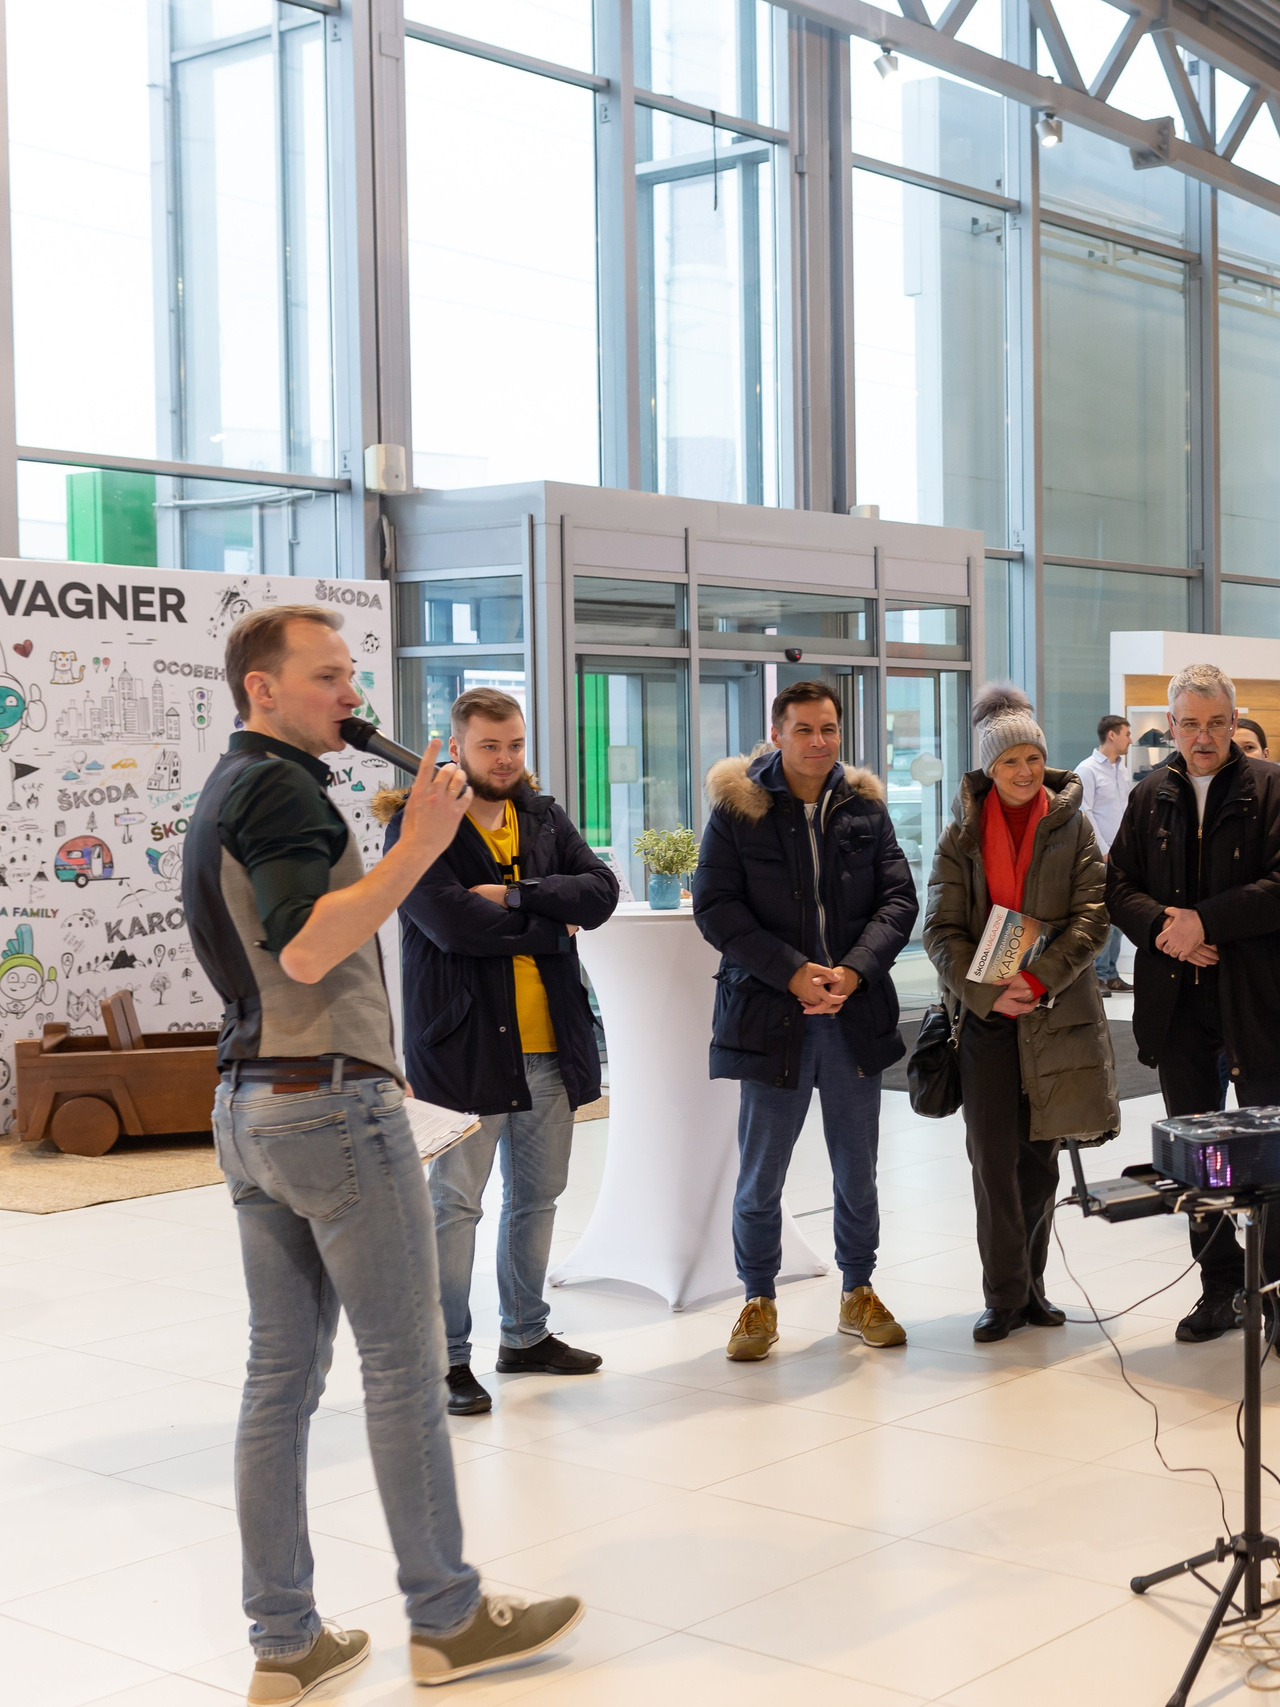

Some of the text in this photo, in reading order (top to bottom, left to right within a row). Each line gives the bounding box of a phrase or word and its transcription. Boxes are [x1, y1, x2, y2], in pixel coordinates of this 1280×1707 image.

[315, 579, 383, 611] ŠKODA
[330, 766, 354, 787] ILY
[57, 783, 139, 812] ŠKODA
[13, 908, 59, 919] FAMILY
[997, 925, 1026, 979] KAROQ
